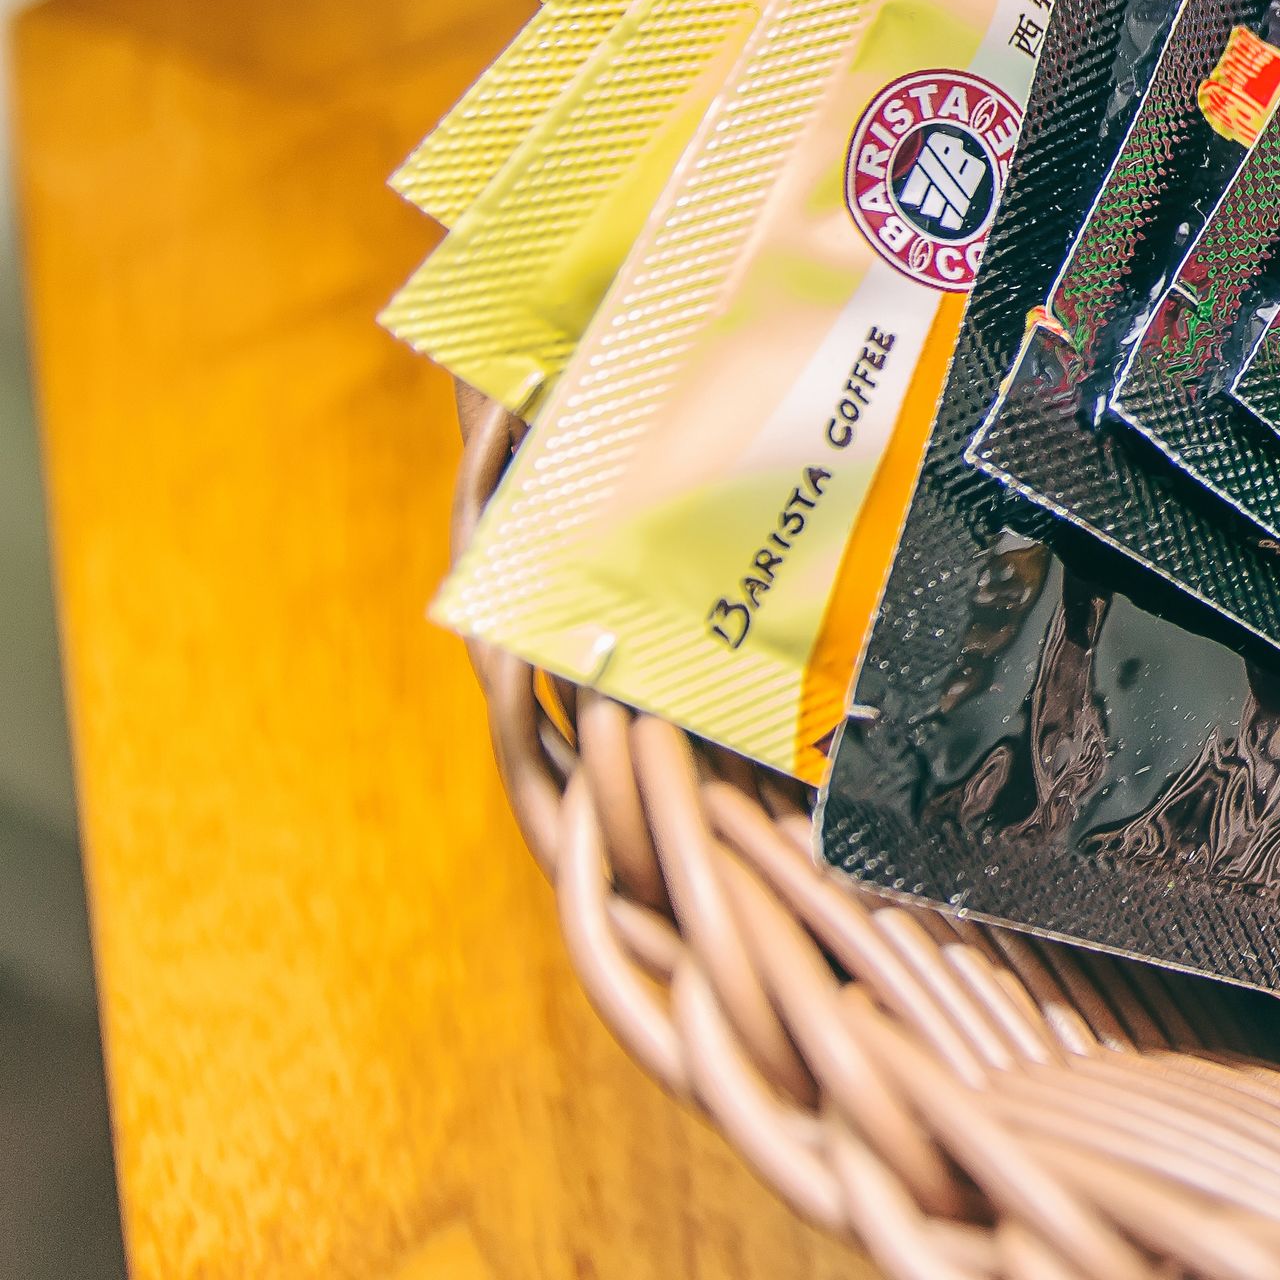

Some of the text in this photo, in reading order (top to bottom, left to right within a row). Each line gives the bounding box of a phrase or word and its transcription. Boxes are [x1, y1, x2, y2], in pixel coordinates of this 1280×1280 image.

[857, 83, 970, 252] BARISTA
[709, 325, 895, 648] BARISTA COFFEE
